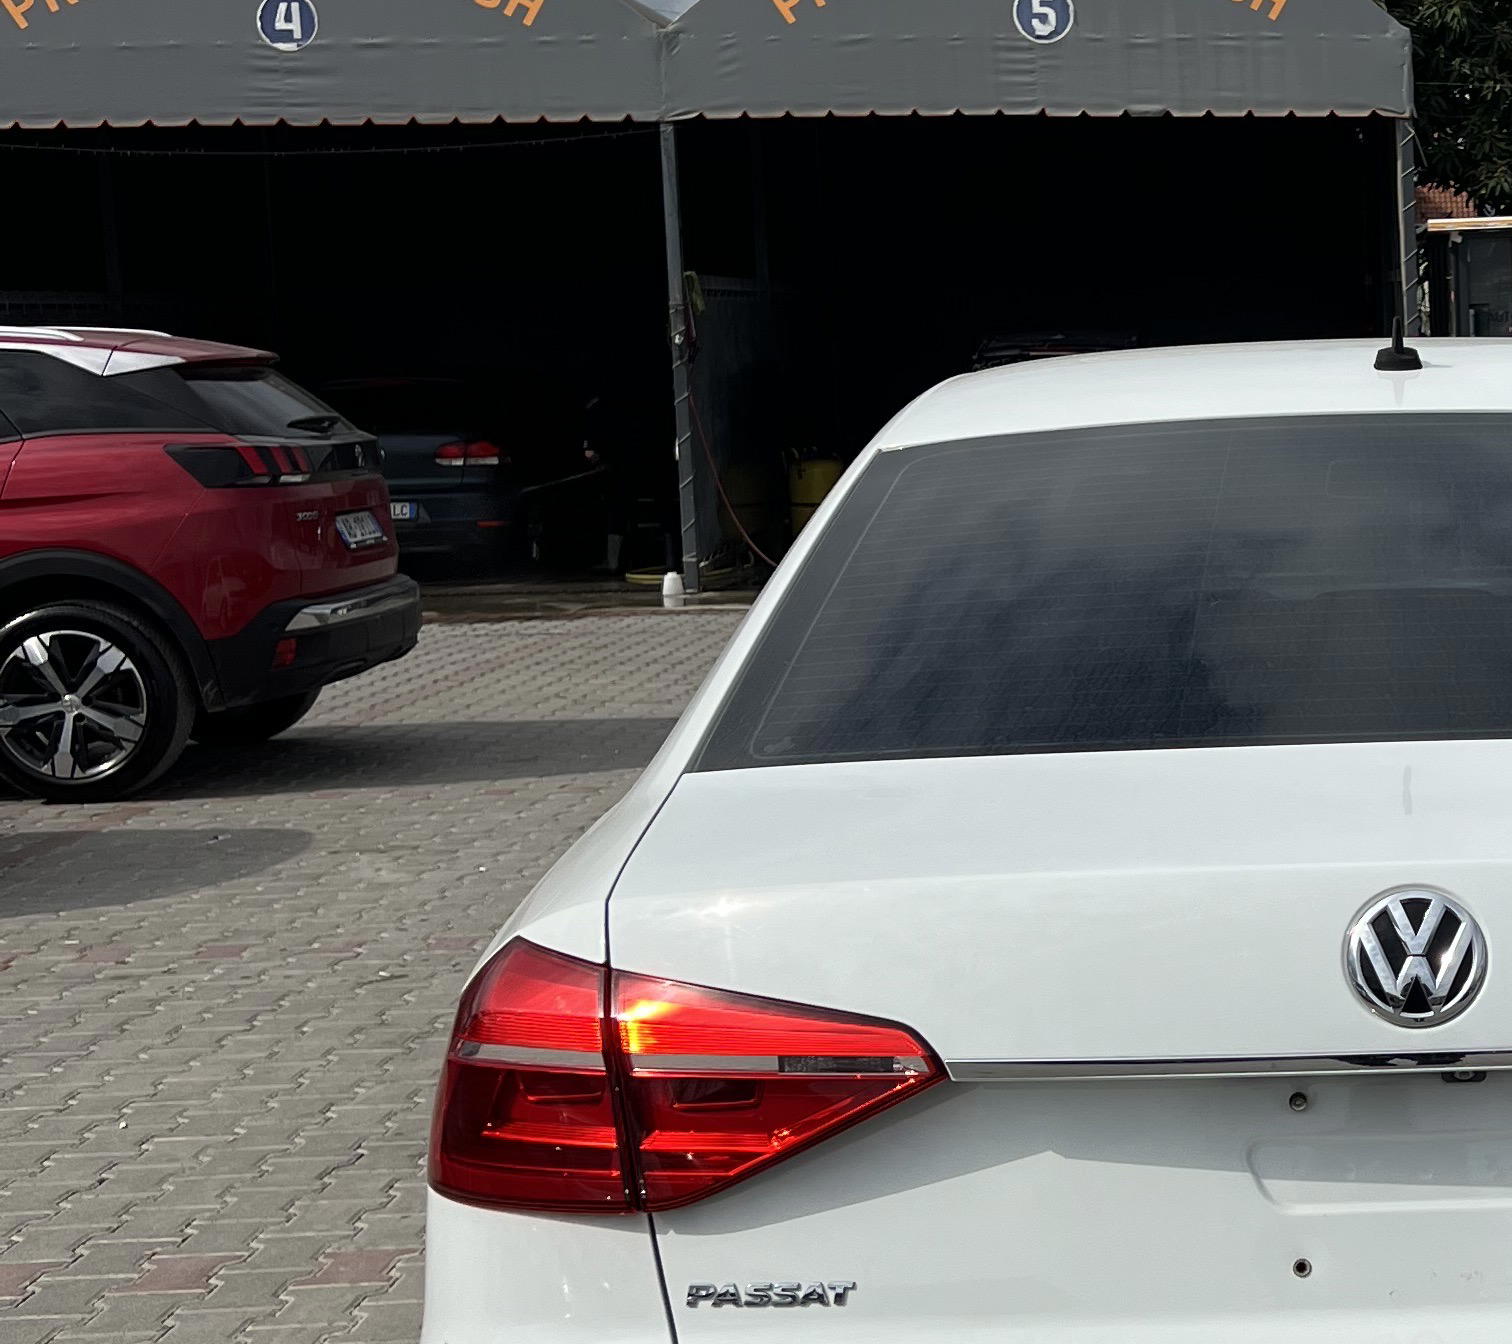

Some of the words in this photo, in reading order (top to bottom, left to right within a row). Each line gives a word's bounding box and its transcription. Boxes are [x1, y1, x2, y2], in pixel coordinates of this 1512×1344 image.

[274, 1, 302, 39] 4
[1348, 892, 1485, 1026] VW
[686, 1281, 858, 1308] PASSAT
